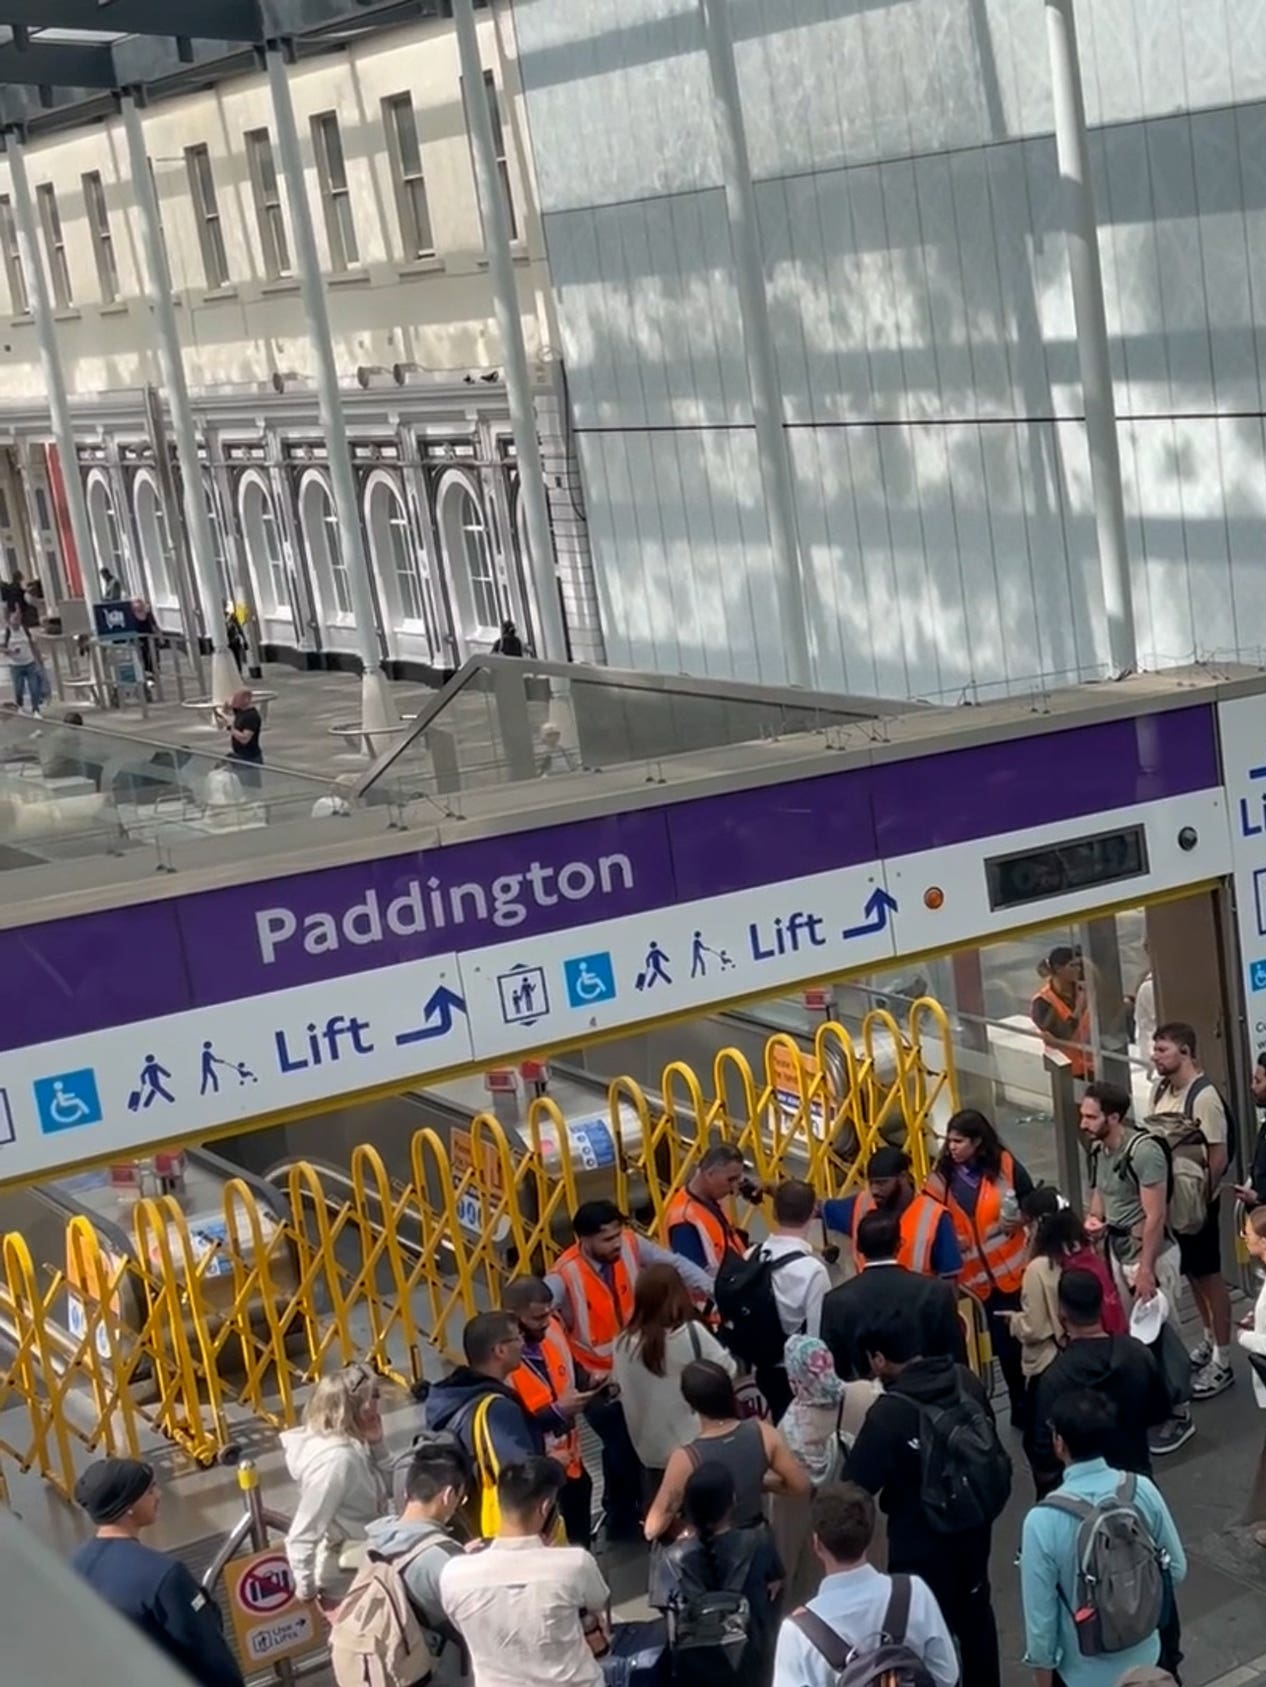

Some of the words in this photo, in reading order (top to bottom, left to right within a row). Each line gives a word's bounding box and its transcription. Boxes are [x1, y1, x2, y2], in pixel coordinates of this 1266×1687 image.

[255, 853, 634, 964] Paddington
[749, 912, 826, 960] Lift
[275, 1015, 374, 1073] Lift
